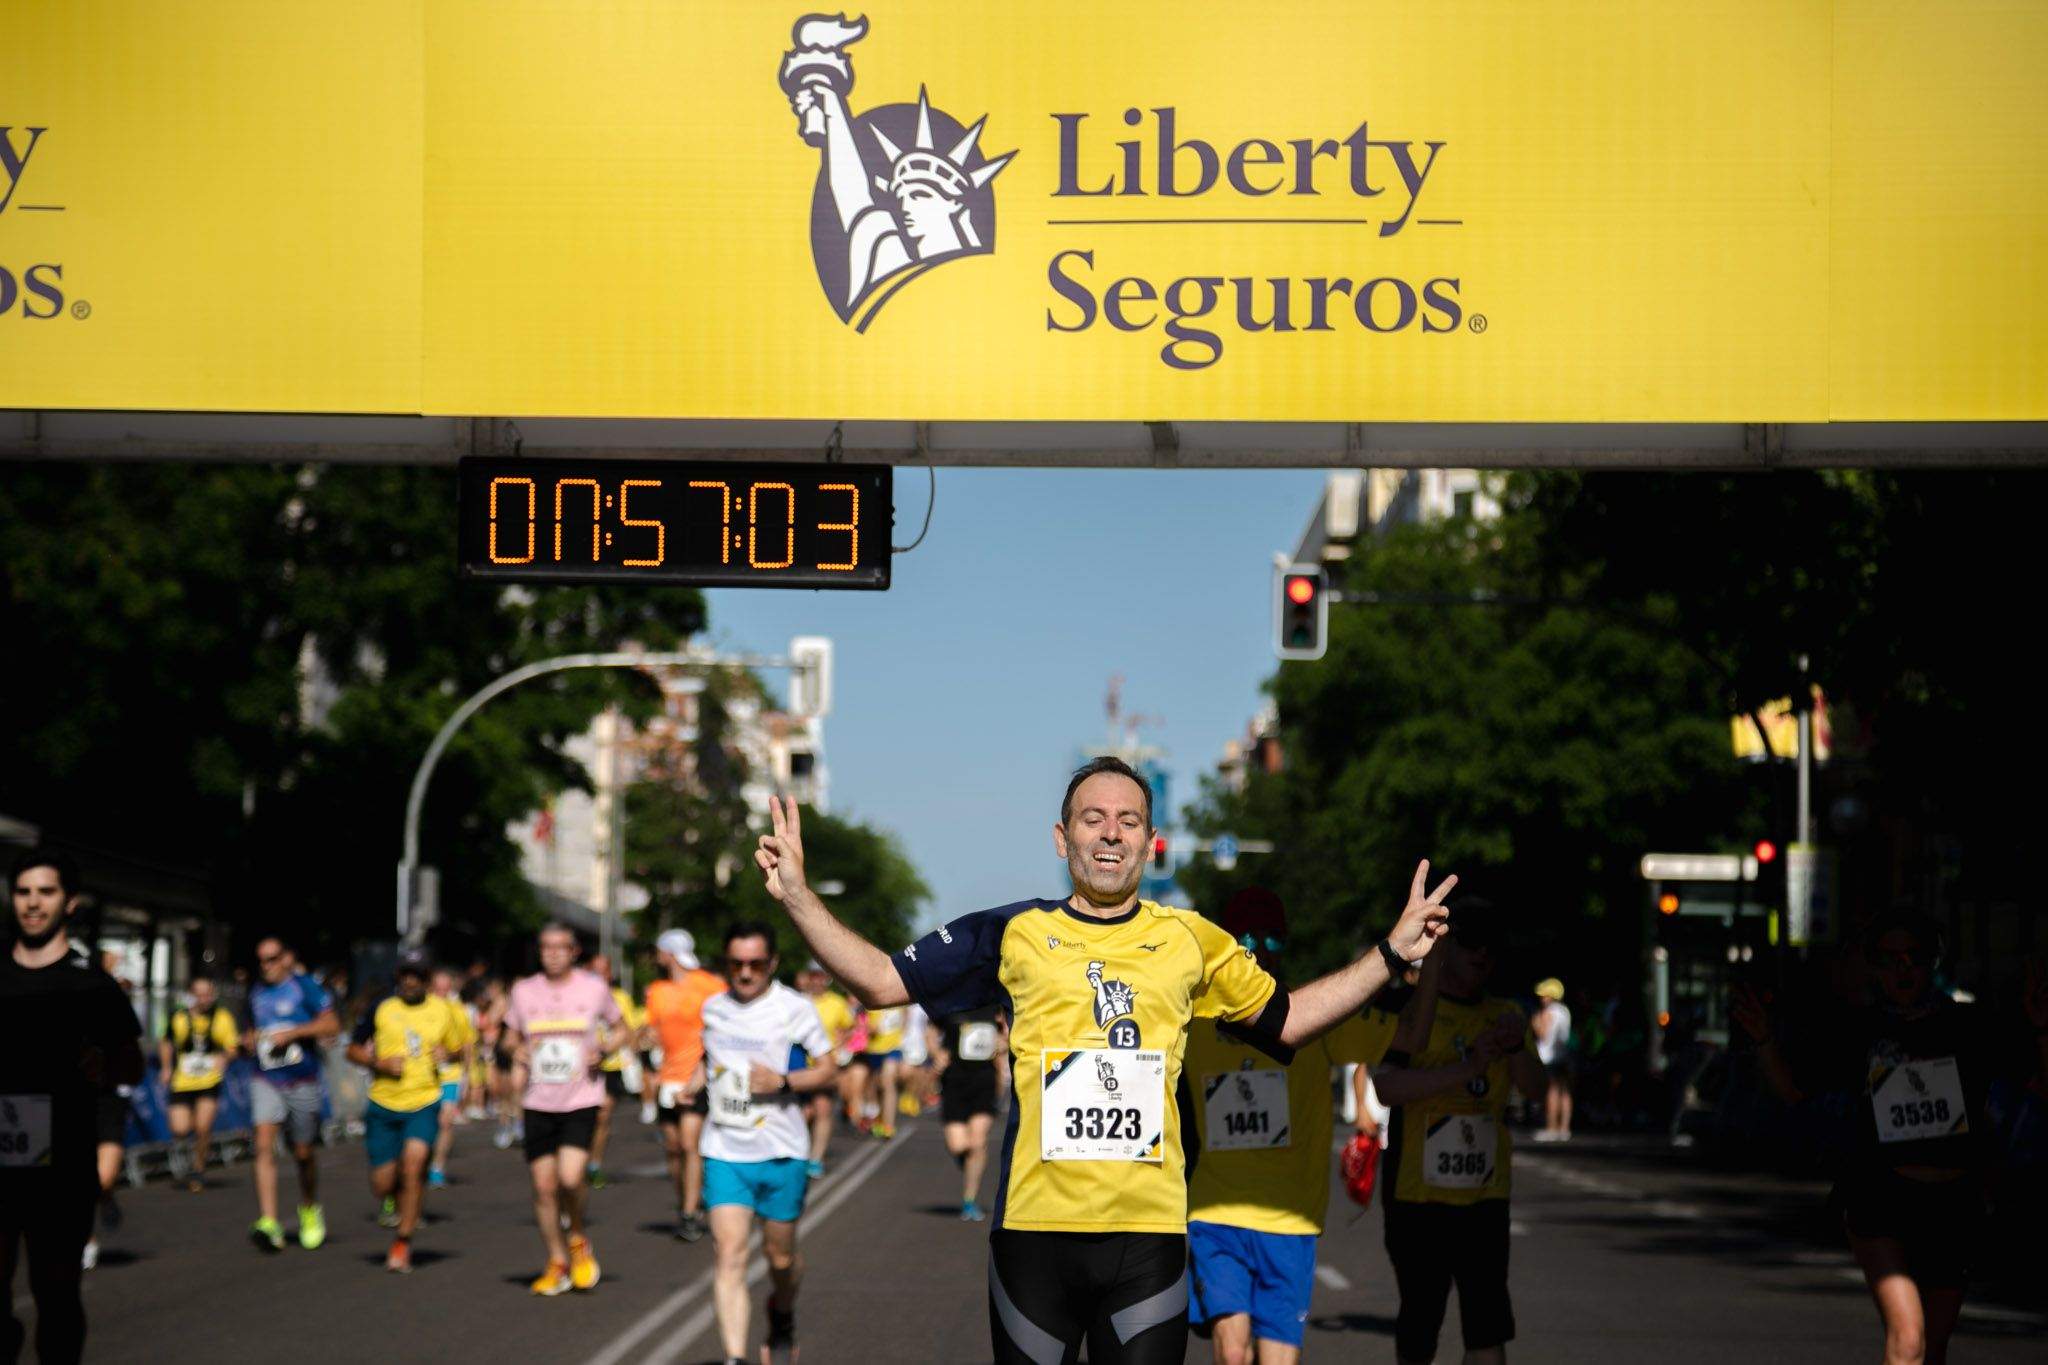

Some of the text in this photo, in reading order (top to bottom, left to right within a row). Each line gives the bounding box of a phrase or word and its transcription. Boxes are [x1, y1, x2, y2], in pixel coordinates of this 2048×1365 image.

[1049, 106, 1447, 237] Liberty
[1114, 1026, 1136, 1048] 13
[1105, 1079, 1117, 1090] 13
[1065, 1107, 1142, 1140] 3323
[1224, 1111, 1269, 1136] 1441
[1890, 1098, 1950, 1129] 3538
[1438, 1152, 1486, 1176] 3365
